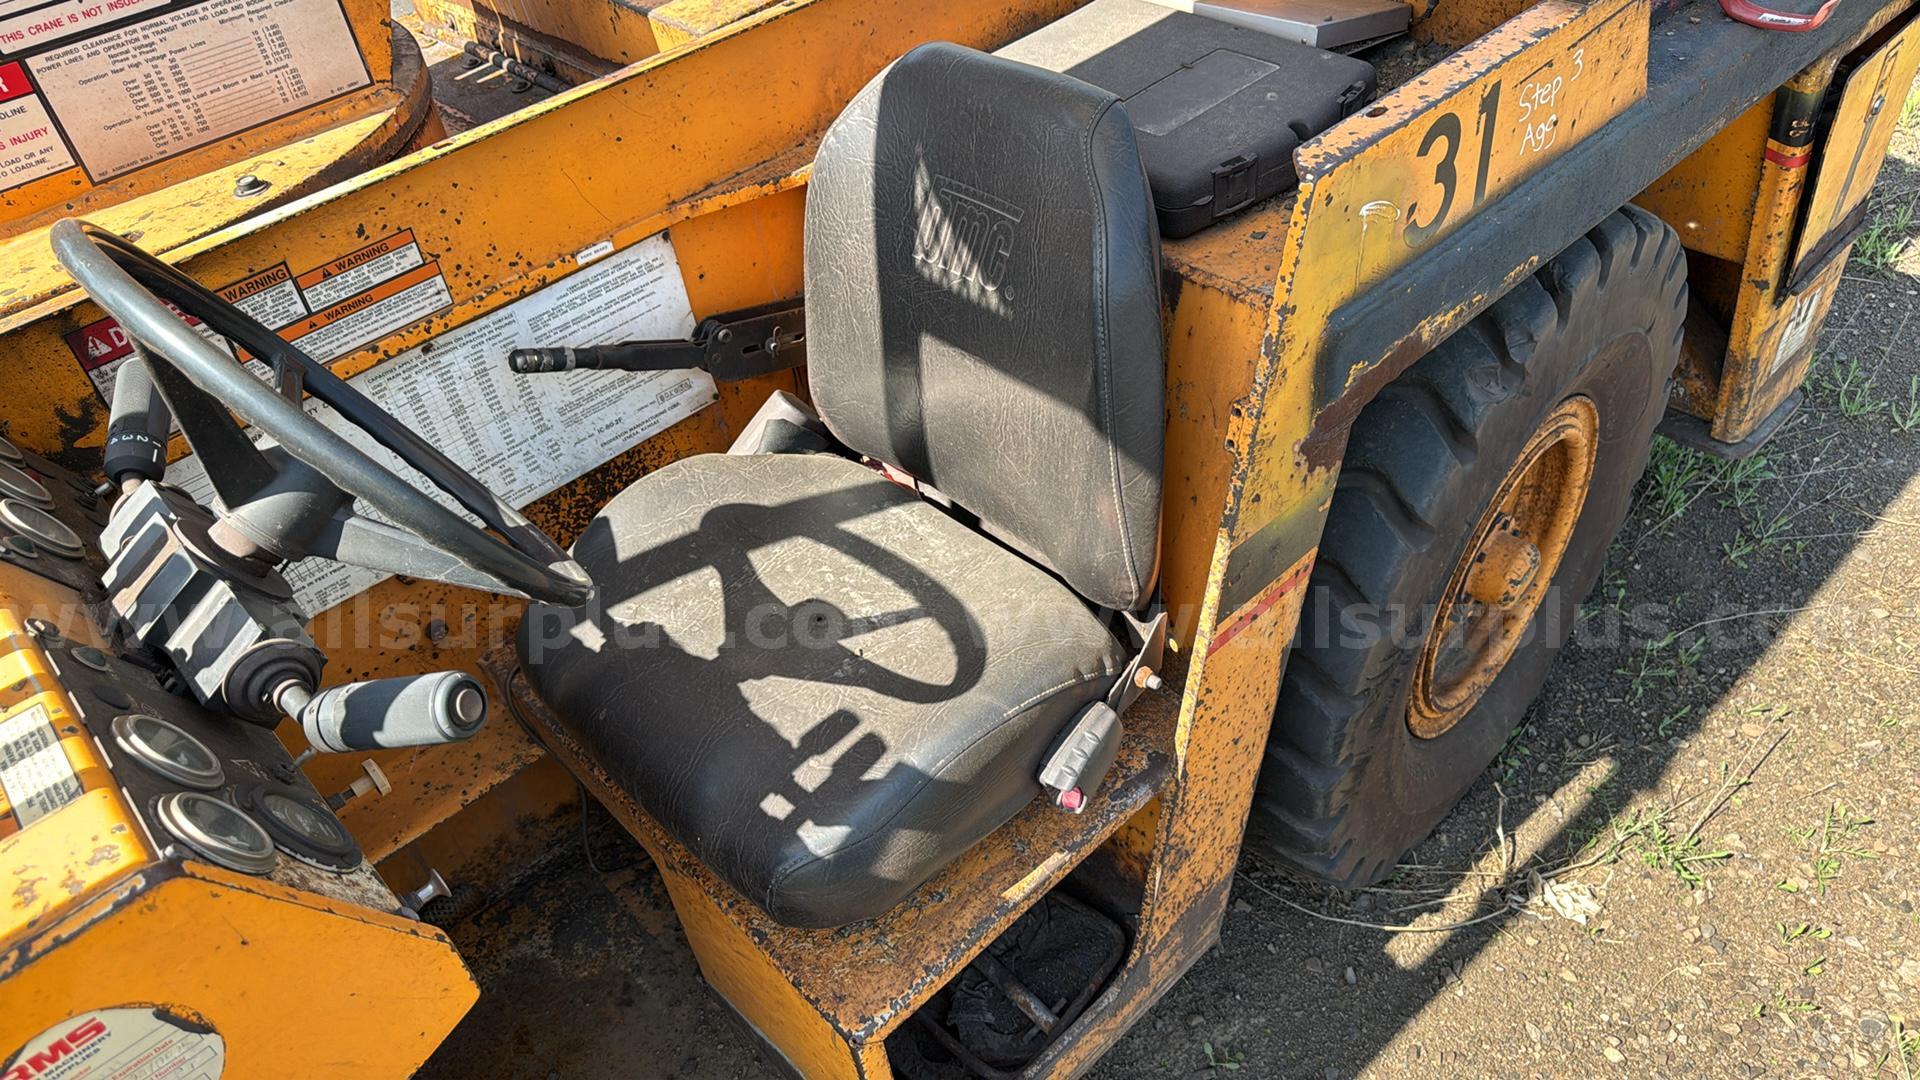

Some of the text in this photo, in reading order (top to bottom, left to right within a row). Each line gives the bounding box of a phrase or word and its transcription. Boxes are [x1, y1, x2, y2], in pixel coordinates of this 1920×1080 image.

[0, 32, 25, 45] THIS
[28, 17, 65, 37] CRANE
[68, 13, 79, 24] IS
[82, 5, 103, 20] NOT
[36, 62, 61, 74] POWER
[64, 55, 84, 65] LINES
[87, 49, 101, 58] AND
[103, 37, 140, 52] OPERATION
[152, 24, 177, 36] TRANSIT
[181, 19, 197, 27] WITH
[199, 14, 208, 22] NO
[210, 8, 228, 18] LOAD
[231, 3, 244, 11] AND
[45, 47, 79, 62] REQUIRED
[82, 34, 121, 50] CLEARANCE
[124, 28, 138, 37] FOR
[140, 20, 167, 31] NORMAL
[169, 9, 199, 22] VOLTAGE
[78, 73, 108, 85] Operation
[127, 61, 142, 69] High
[144, 53, 167, 63] Voltage
[169, 46, 187, 55] Power
[189, 40, 206, 49] Lines
[1518, 48, 1585, 123] Step 3
[9, 126, 49, 147] INJURY
[0, 145, 54, 169] LOAD OR ANY
[1403, 80, 1503, 248] 31
[335, 243, 389, 270] WARNING
[224, 269, 286, 302] WARNING
[251, 290, 293, 312] MUST SOUND
[324, 294, 373, 320] WARNING
[154, 1038, 174, 1055] Date
